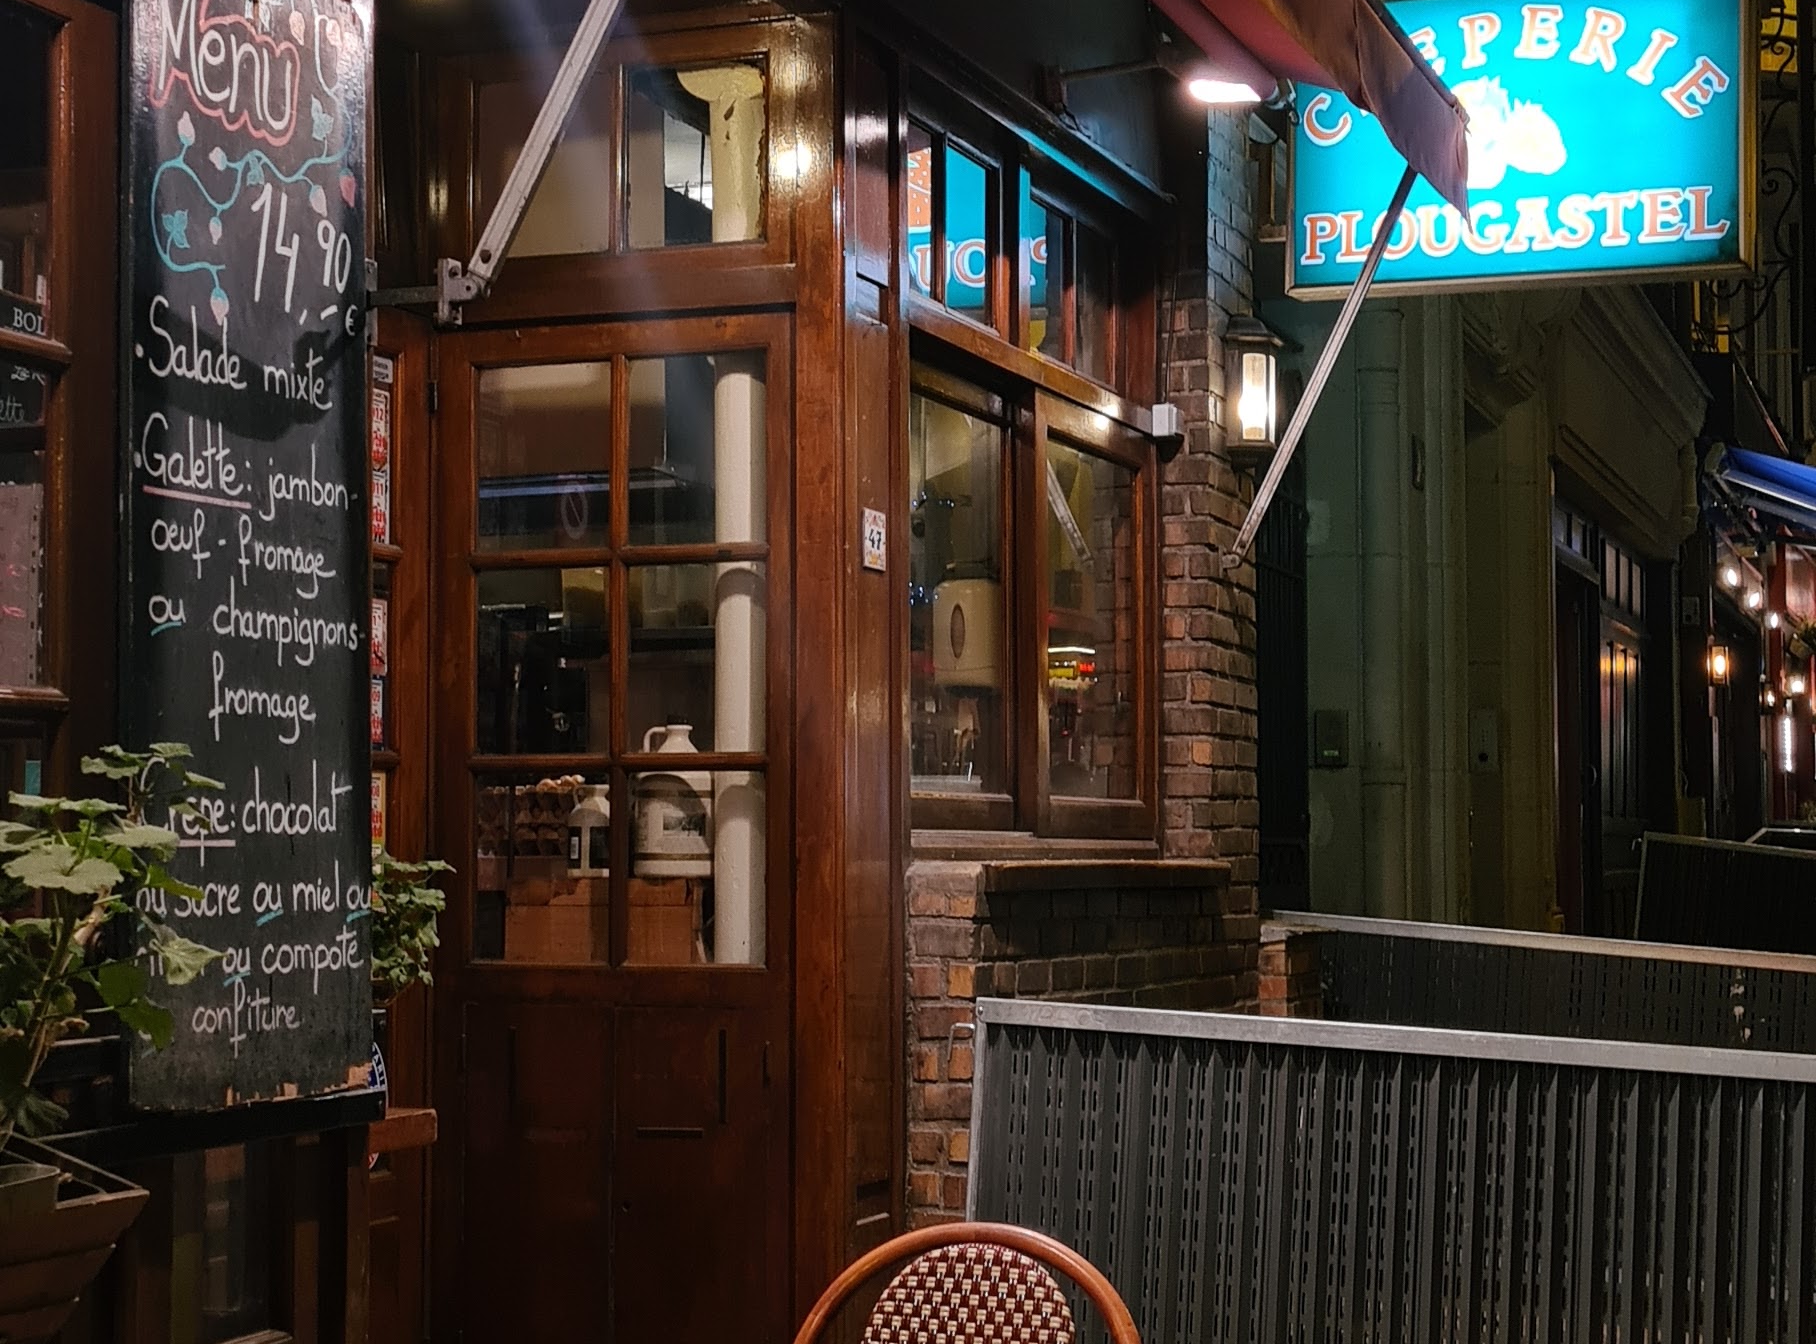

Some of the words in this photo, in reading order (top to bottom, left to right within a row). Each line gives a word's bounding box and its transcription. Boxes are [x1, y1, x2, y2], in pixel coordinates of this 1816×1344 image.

[1303, 3, 1731, 147] CEPERIE
[1300, 185, 1731, 266] PLOUGASTEL
[149, 294, 247, 390] Salade
[263, 347, 333, 411] mixte
[141, 412, 252, 496] Galette:
[151, 508, 211, 580] oeuf
[238, 513, 336, 599] fromage
[868, 528, 882, 551] 47
[149, 594, 186, 624] ou
[208, 651, 316, 745] fromage
[242, 759, 352, 834] chocolat
[253, 880, 281, 913] ou
[293, 859, 340, 913] miel
[346, 883, 372, 913] ou
[221, 947, 251, 973] ou
[192, 975, 301, 1058] confiture
